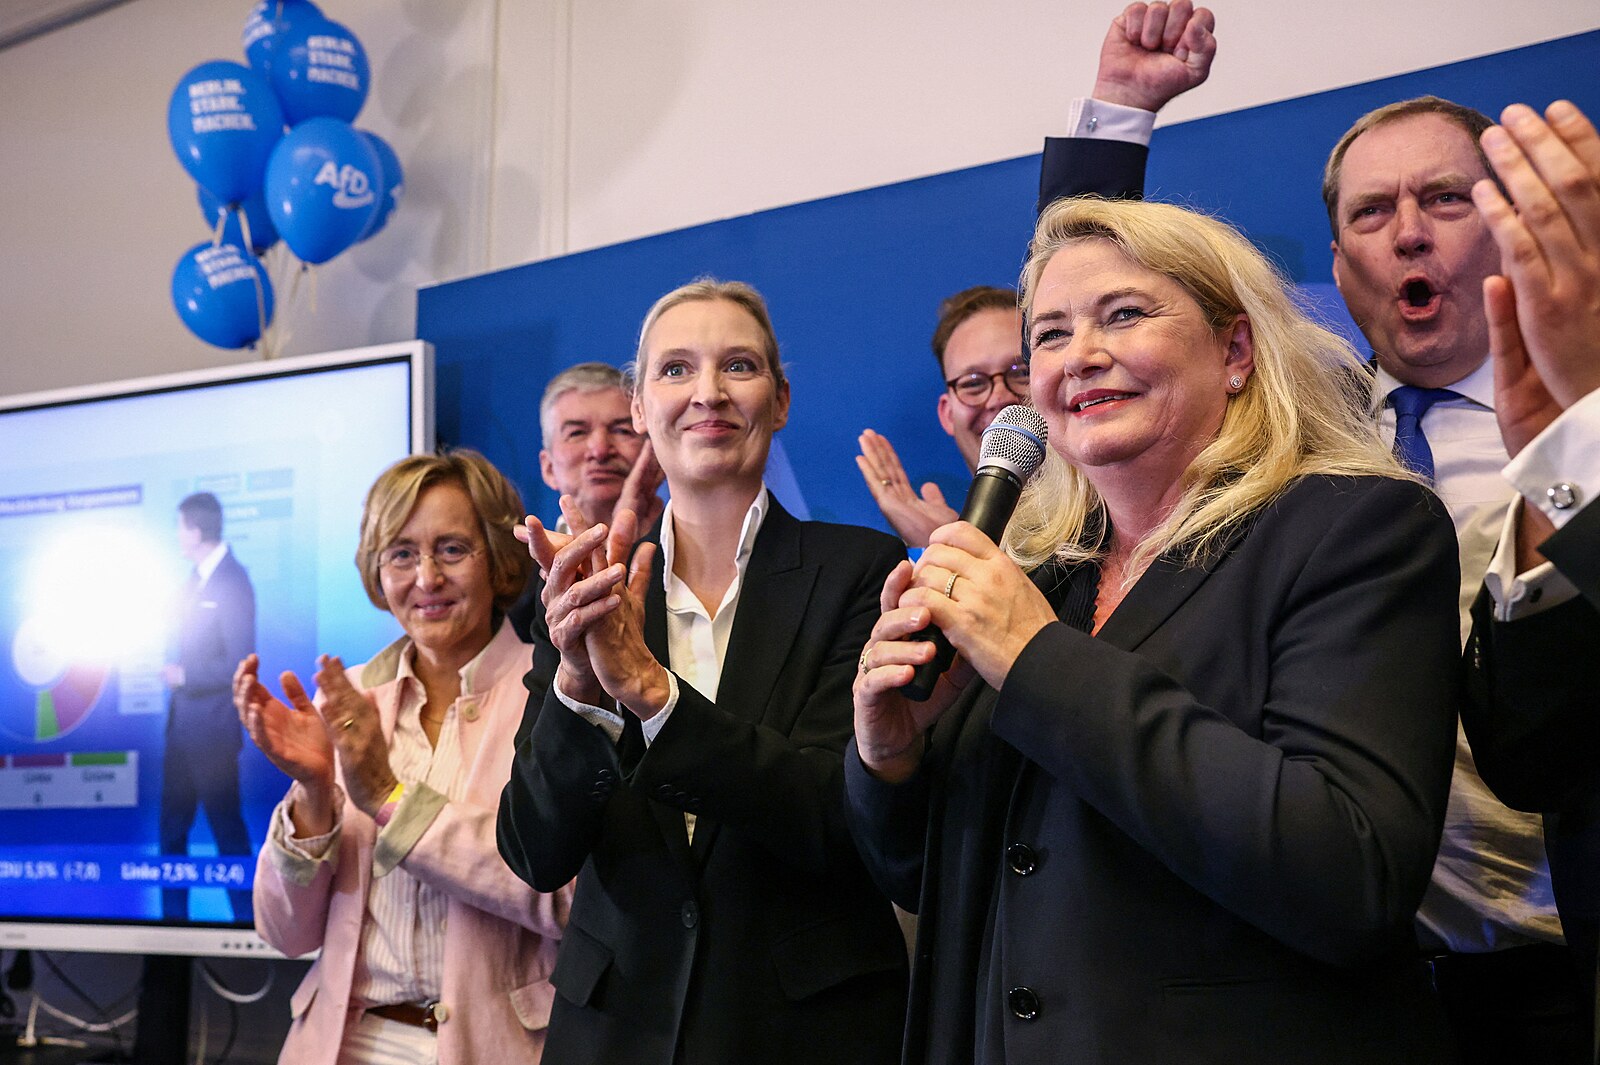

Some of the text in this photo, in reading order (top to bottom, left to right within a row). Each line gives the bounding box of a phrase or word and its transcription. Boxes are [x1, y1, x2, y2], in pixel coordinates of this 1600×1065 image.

[190, 95, 245, 115] STARK.
[192, 113, 257, 134] MACHEN.
[313, 161, 368, 195] AfD
[121, 862, 160, 880] Linke
[161, 862, 199, 882] 7,5%
[203, 863, 245, 885] (-2,4)
